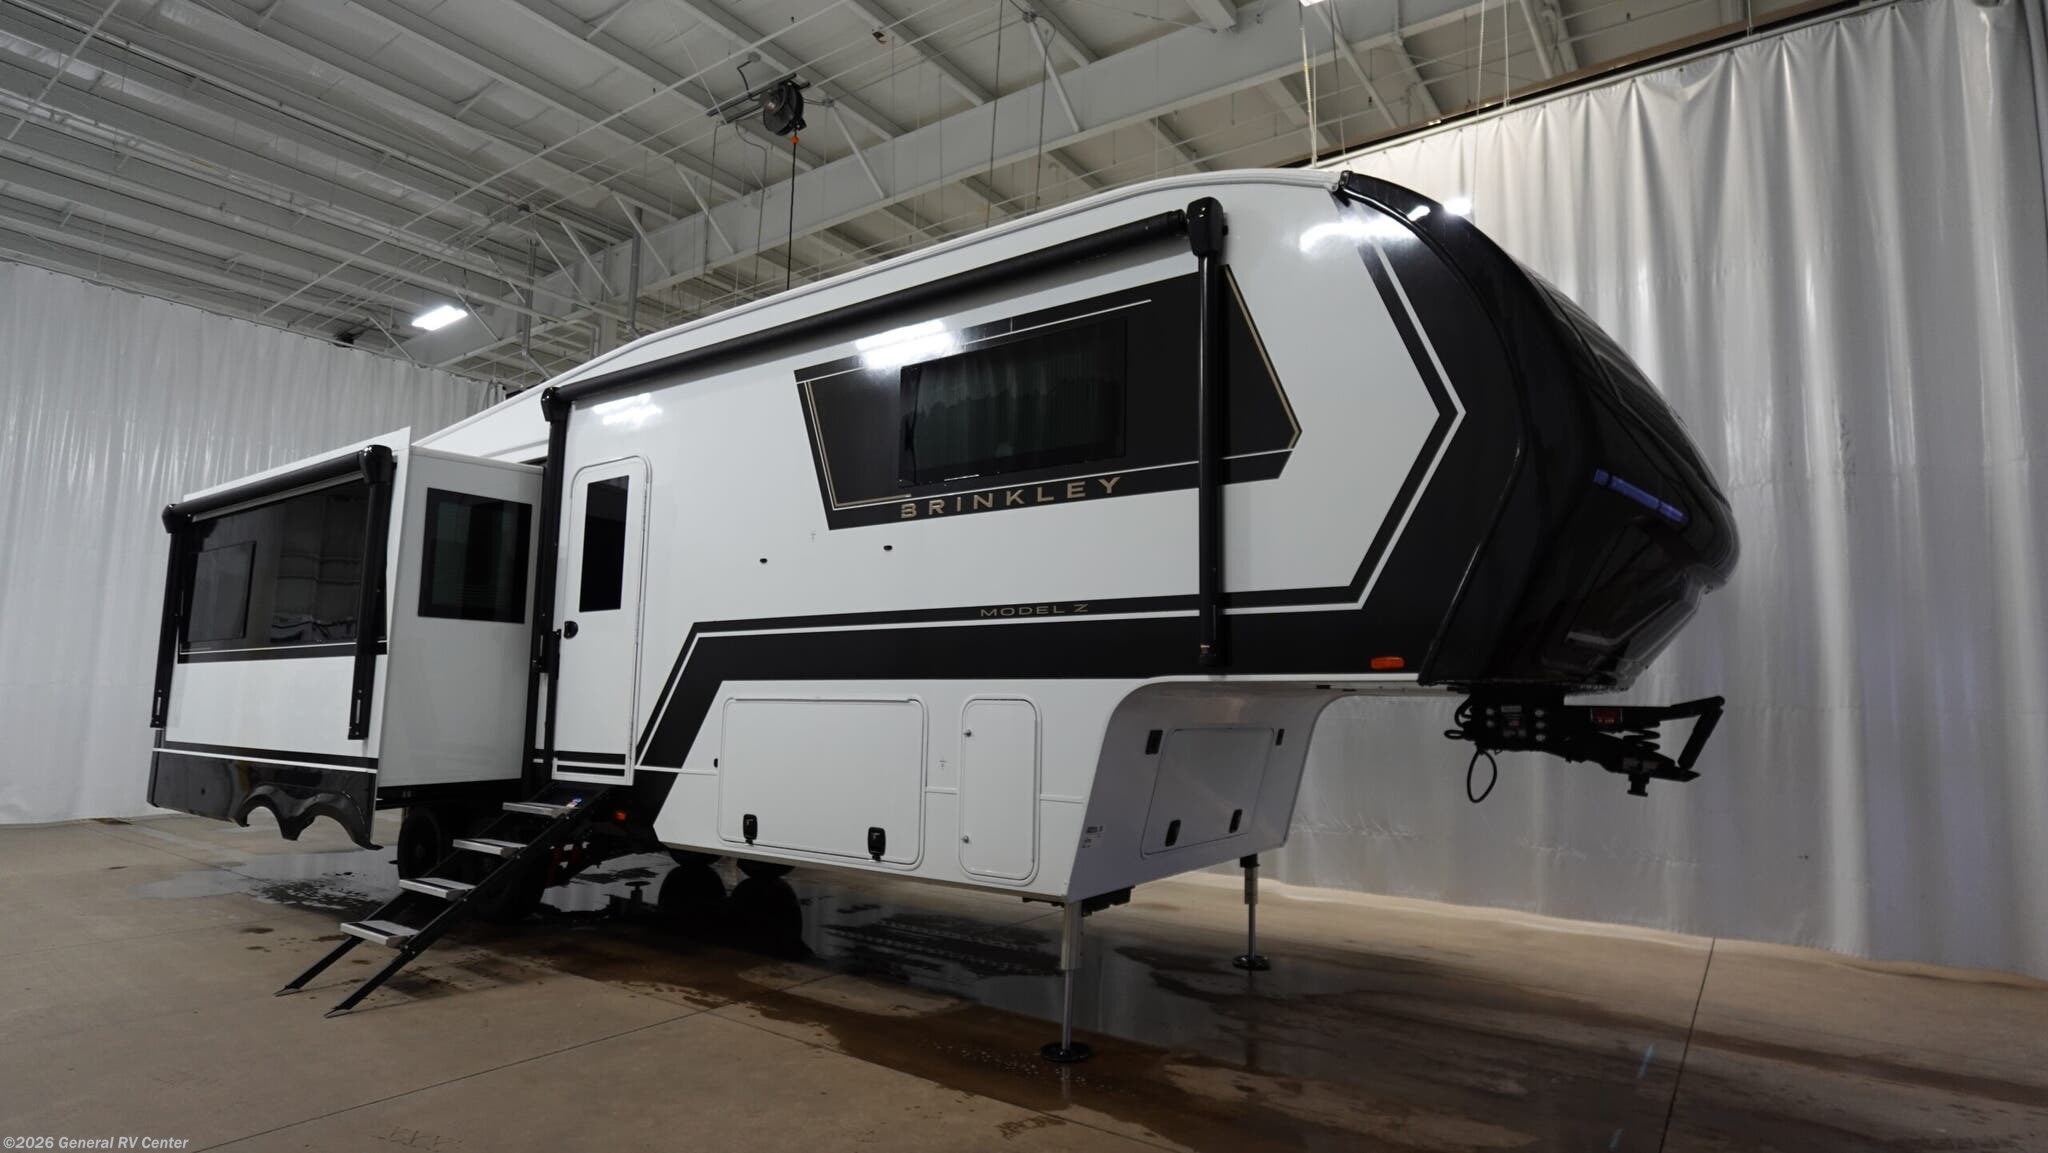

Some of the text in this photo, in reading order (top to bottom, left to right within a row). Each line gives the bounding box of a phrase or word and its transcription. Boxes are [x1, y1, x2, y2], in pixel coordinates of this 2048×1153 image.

[900, 476, 1121, 519] BRINKLEY
[980, 603, 1089, 617] MODEL Z
